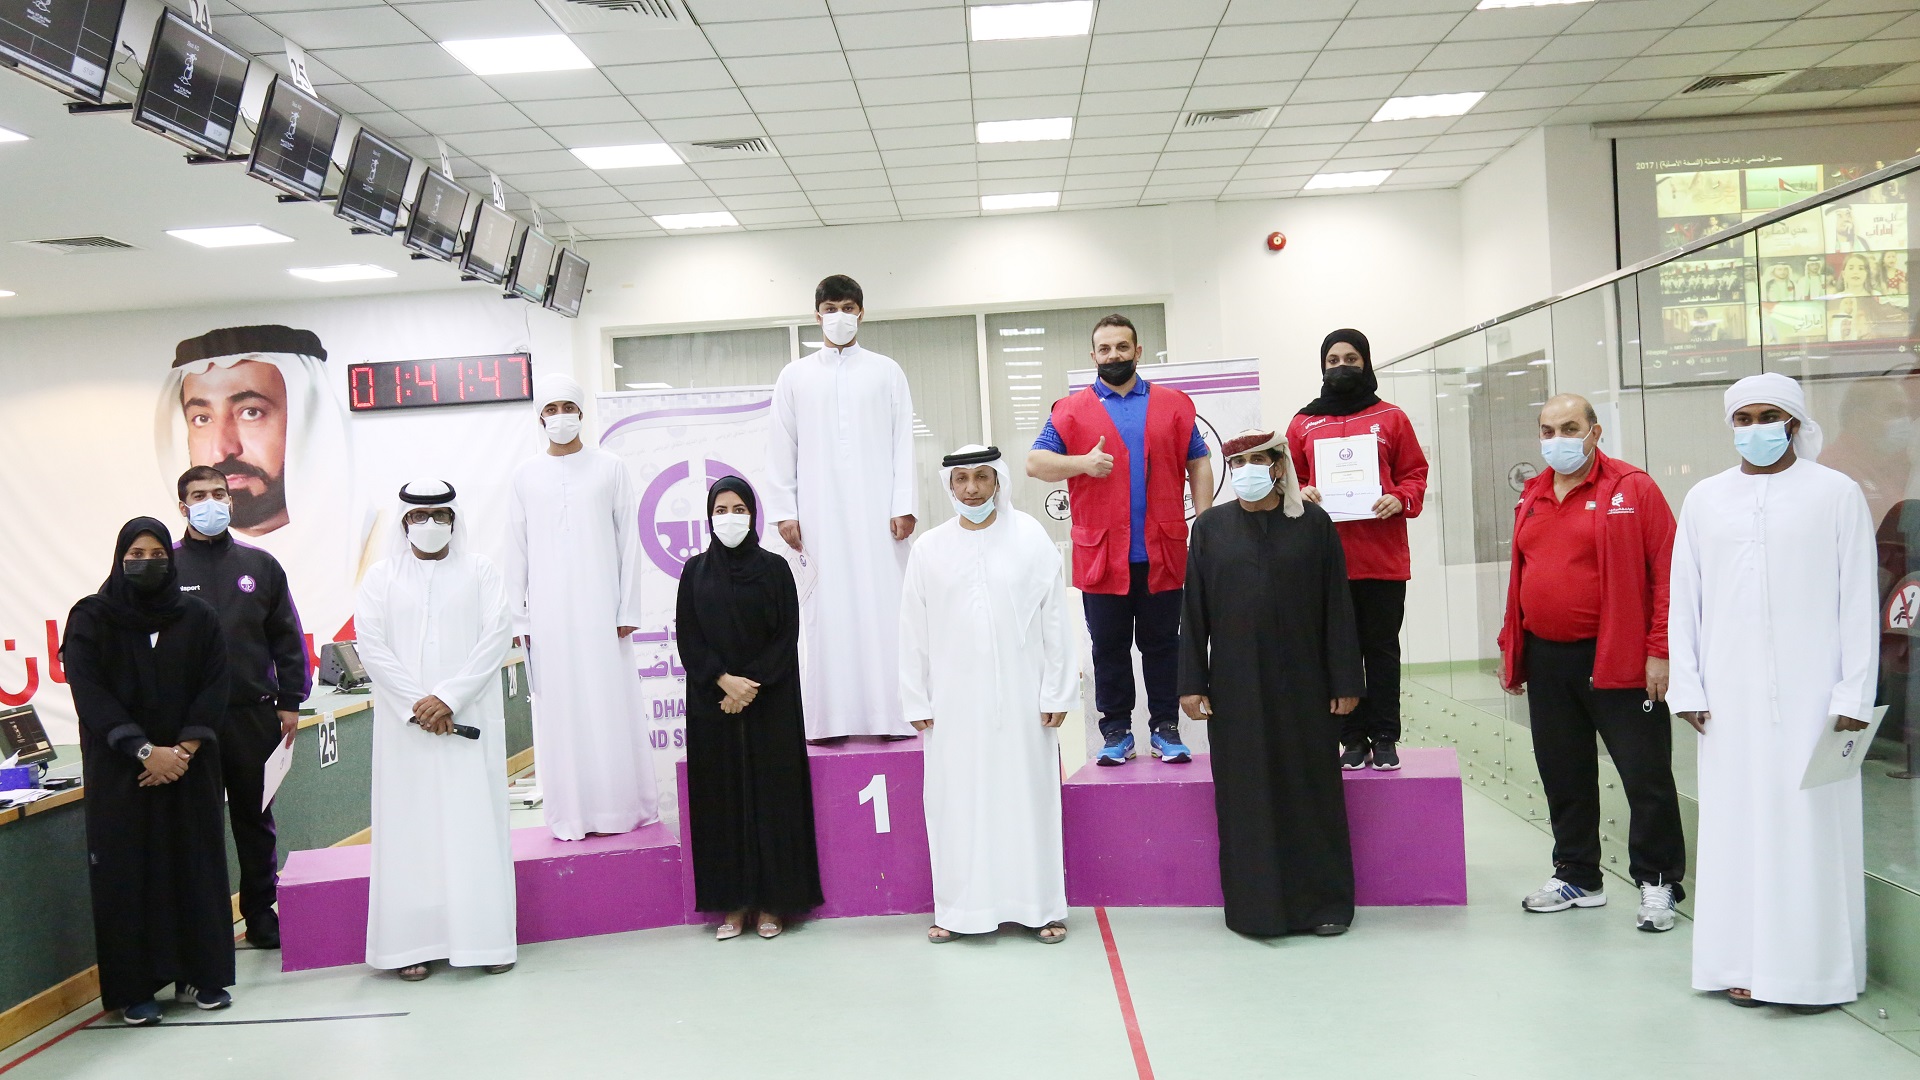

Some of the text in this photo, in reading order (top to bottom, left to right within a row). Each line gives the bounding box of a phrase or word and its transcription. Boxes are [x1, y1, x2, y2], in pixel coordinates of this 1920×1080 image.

[291, 58, 311, 90] 25
[1636, 162, 1654, 170] 2017
[493, 180, 504, 209] 28
[352, 357, 529, 408] 01:41:47
[653, 698, 687, 718] DHA
[320, 721, 337, 765] 25
[649, 729, 668, 748] ND
[858, 774, 890, 833] 1
